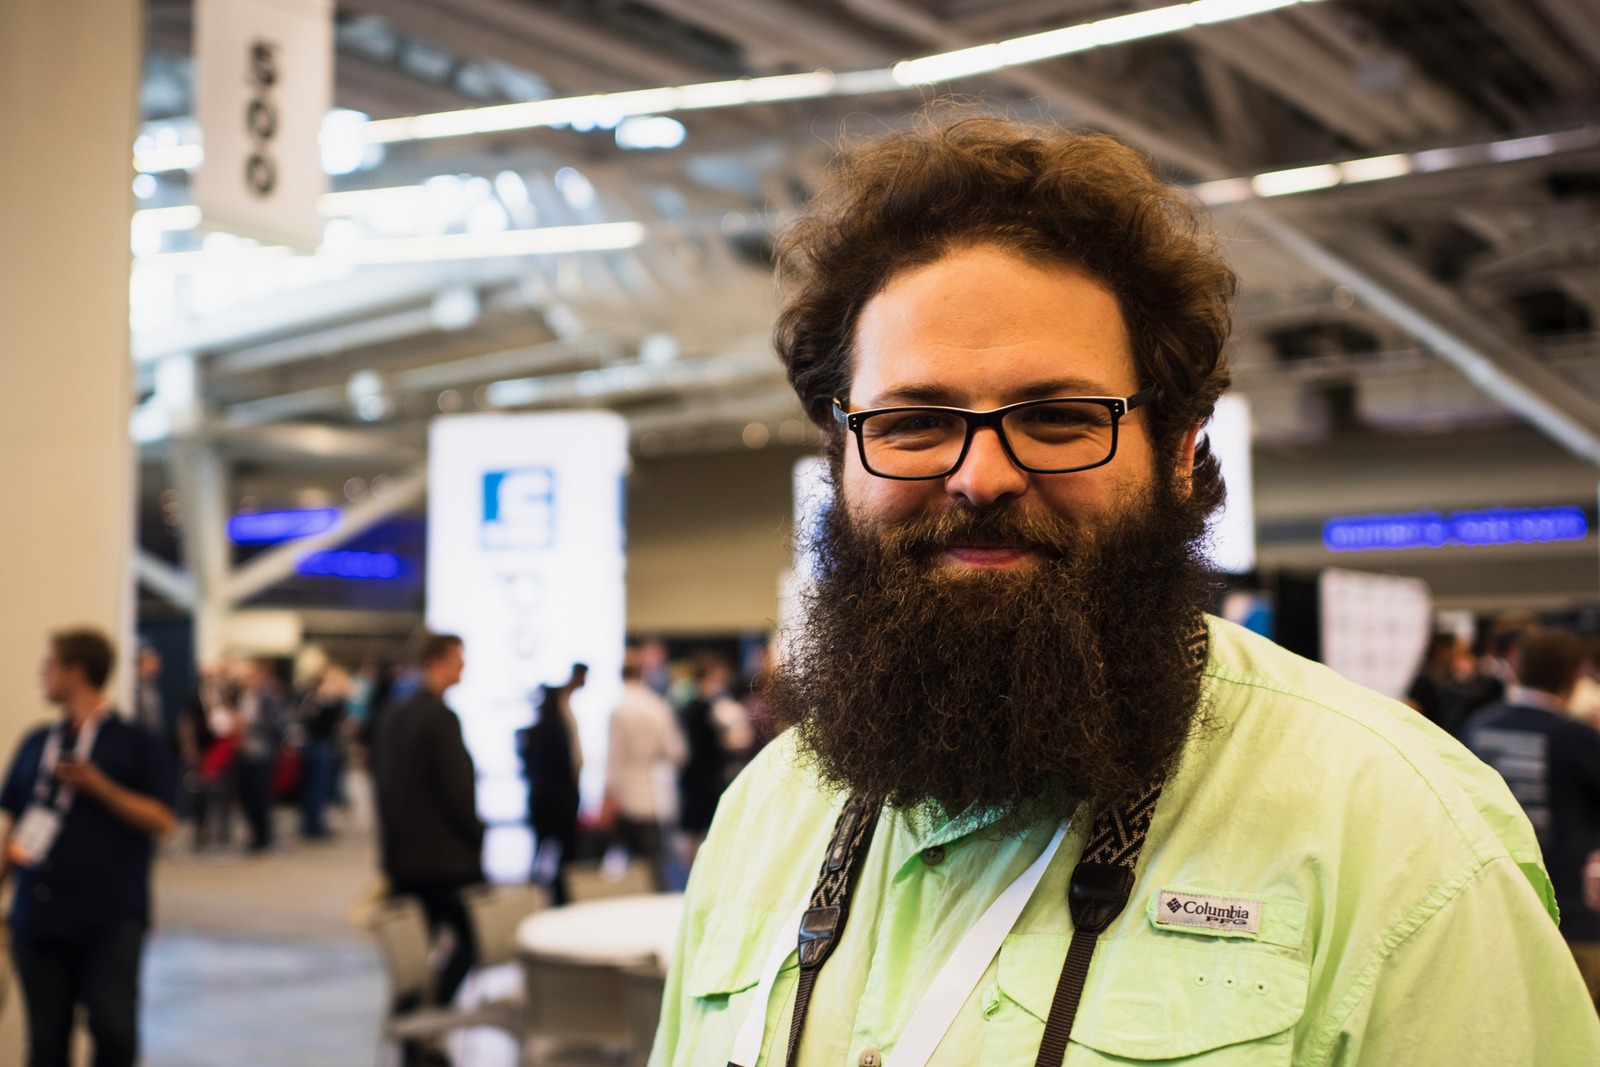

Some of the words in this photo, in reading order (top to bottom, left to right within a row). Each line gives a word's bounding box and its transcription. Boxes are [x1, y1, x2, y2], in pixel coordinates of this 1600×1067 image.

[246, 40, 278, 198] 500
[1183, 900, 1249, 919] Columbia
[1205, 915, 1248, 925] PFG
